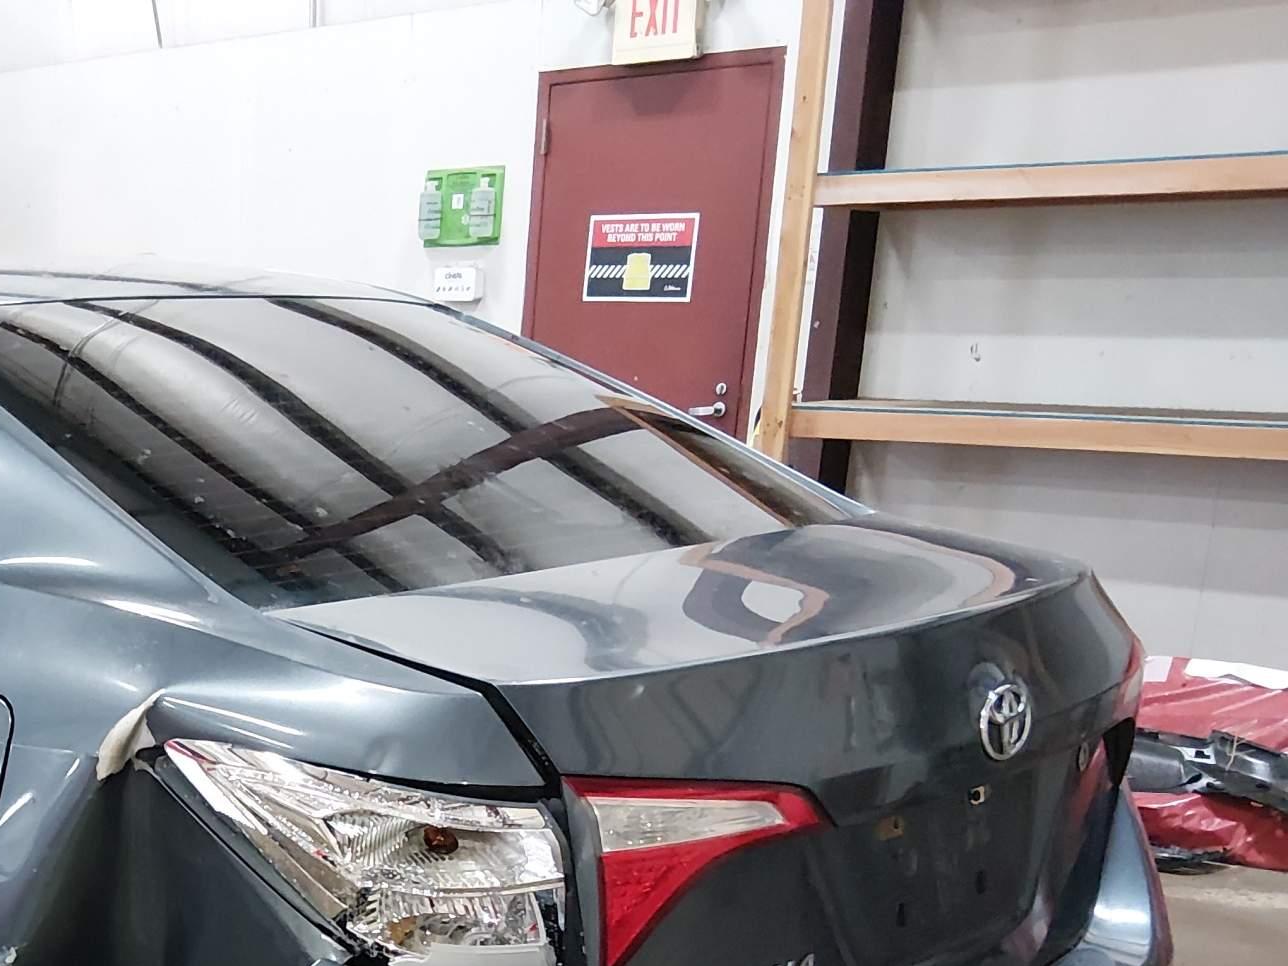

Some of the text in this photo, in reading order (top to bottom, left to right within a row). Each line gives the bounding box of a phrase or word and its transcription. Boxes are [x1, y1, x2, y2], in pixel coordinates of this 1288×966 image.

[601, 221, 686, 234] VESTS ARE TO BE WORN
[607, 231, 678, 242] BEYOND THIS POINT
